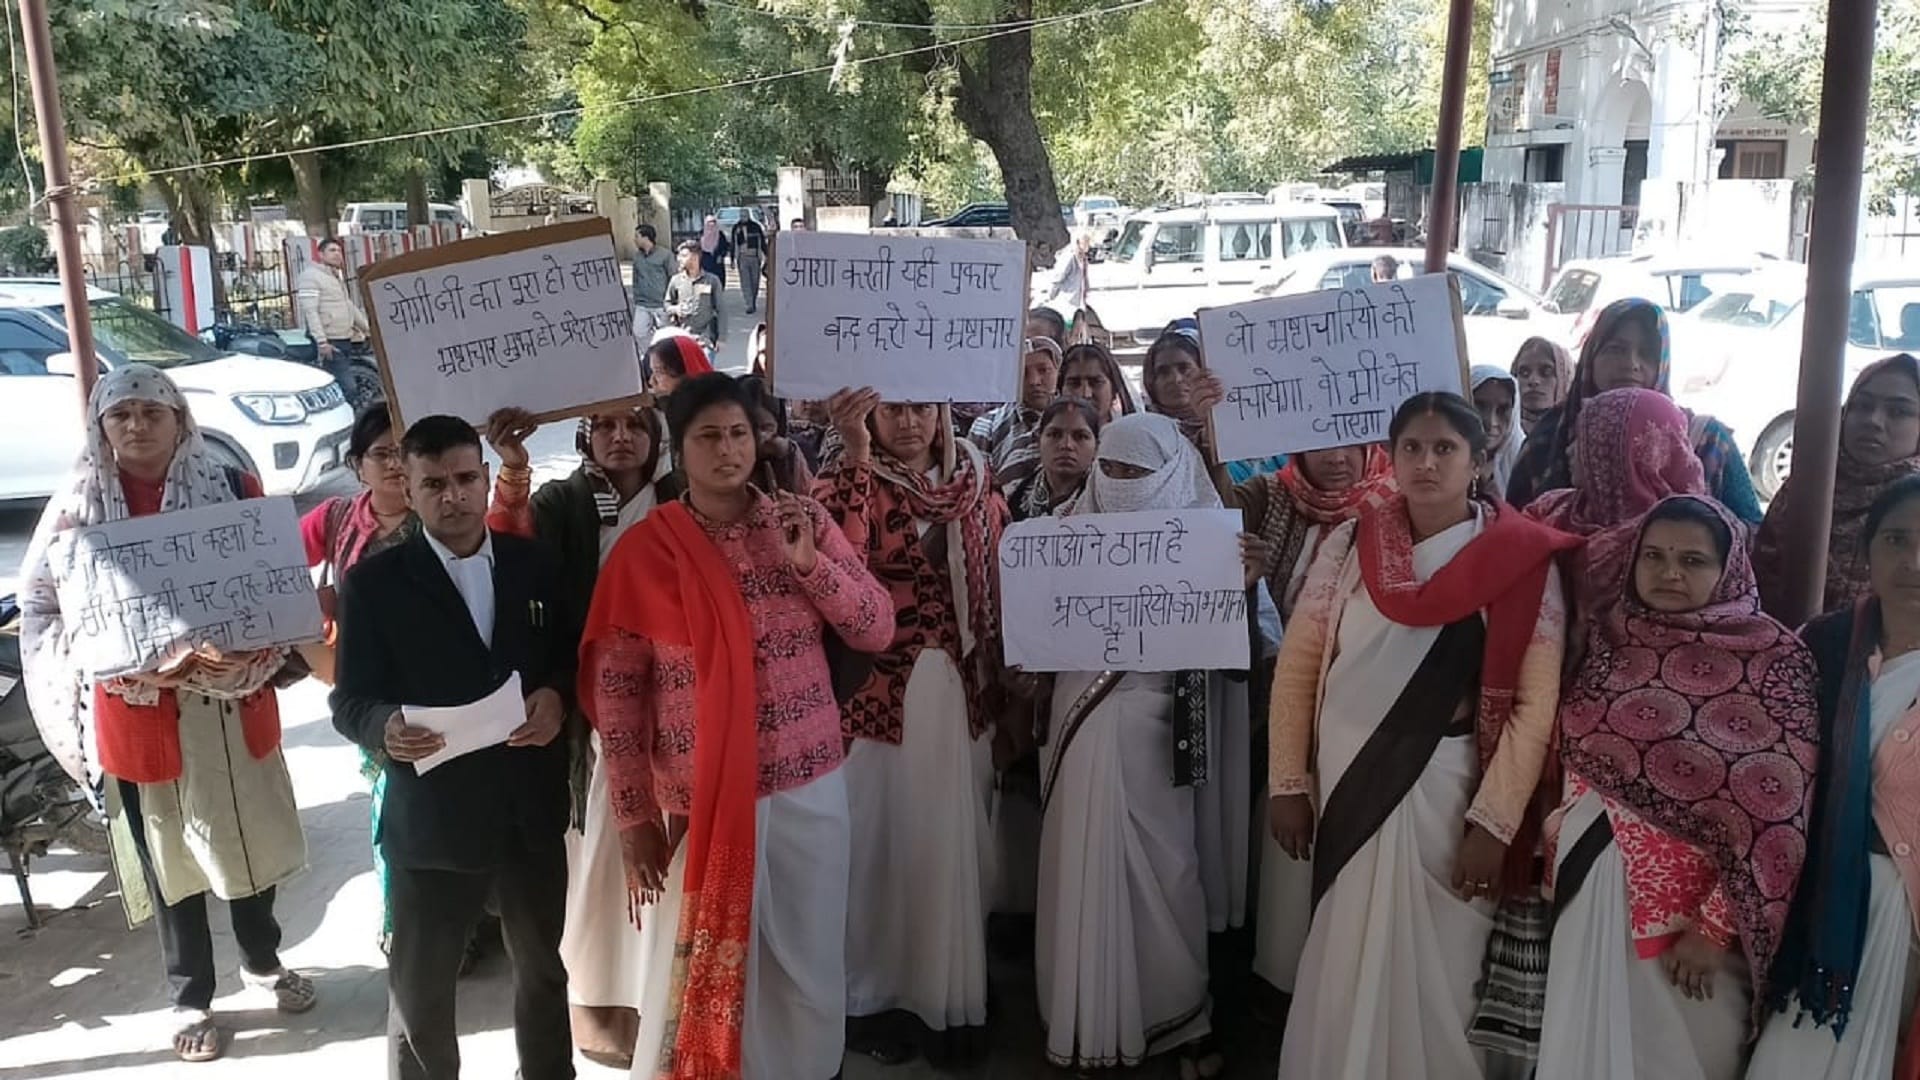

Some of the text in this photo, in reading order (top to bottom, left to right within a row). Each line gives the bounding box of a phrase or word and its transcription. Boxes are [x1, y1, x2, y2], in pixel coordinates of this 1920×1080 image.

[470, 278, 502, 313] का
[508, 270, 540, 305] पूरा
[543, 254, 566, 295] हो
[570, 255, 618, 292] सपना
[783, 245, 1004, 295] आशा करती यही पुकार
[532, 311, 556, 349] हो
[867, 302, 908, 351] करो
[915, 300, 935, 350] ये
[944, 317, 1017, 351] भ्रष्टाचार
[1225, 310, 1257, 355] जो
[1381, 284, 1417, 336] को
[1310, 355, 1342, 407] वो
[1347, 349, 1384, 405] भी
[1381, 352, 1421, 396] जेल
[164, 532, 198, 563] का
[1108, 530, 1165, 566] ठाना
[1165, 517, 1189, 564] है
[188, 581, 219, 612] पर
